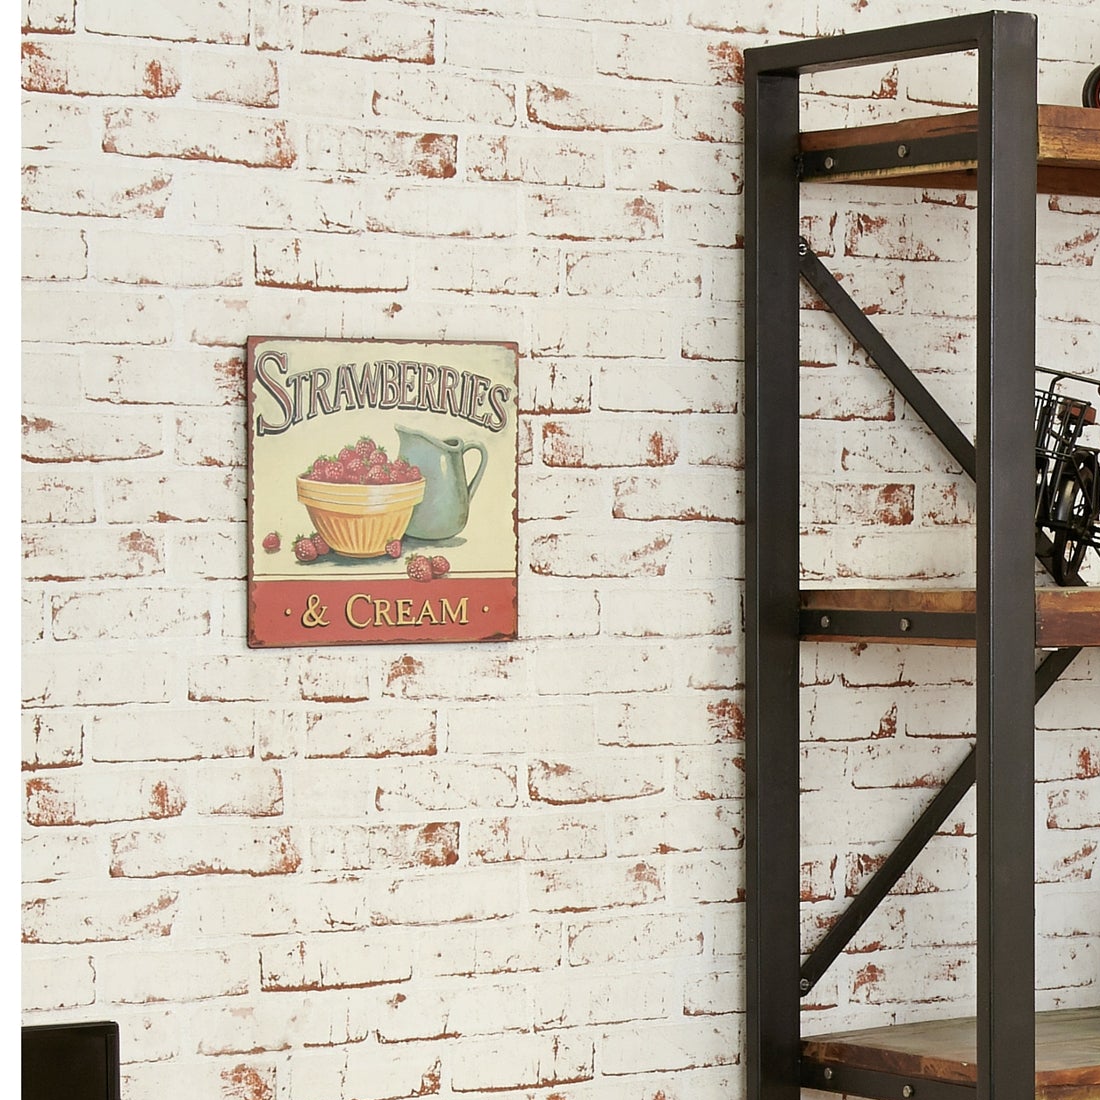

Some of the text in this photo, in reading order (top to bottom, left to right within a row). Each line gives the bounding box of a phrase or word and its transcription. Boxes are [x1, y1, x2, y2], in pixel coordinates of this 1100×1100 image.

[254, 350, 512, 436] STRAWBERRIES
[301, 594, 470, 629] & CREAM
